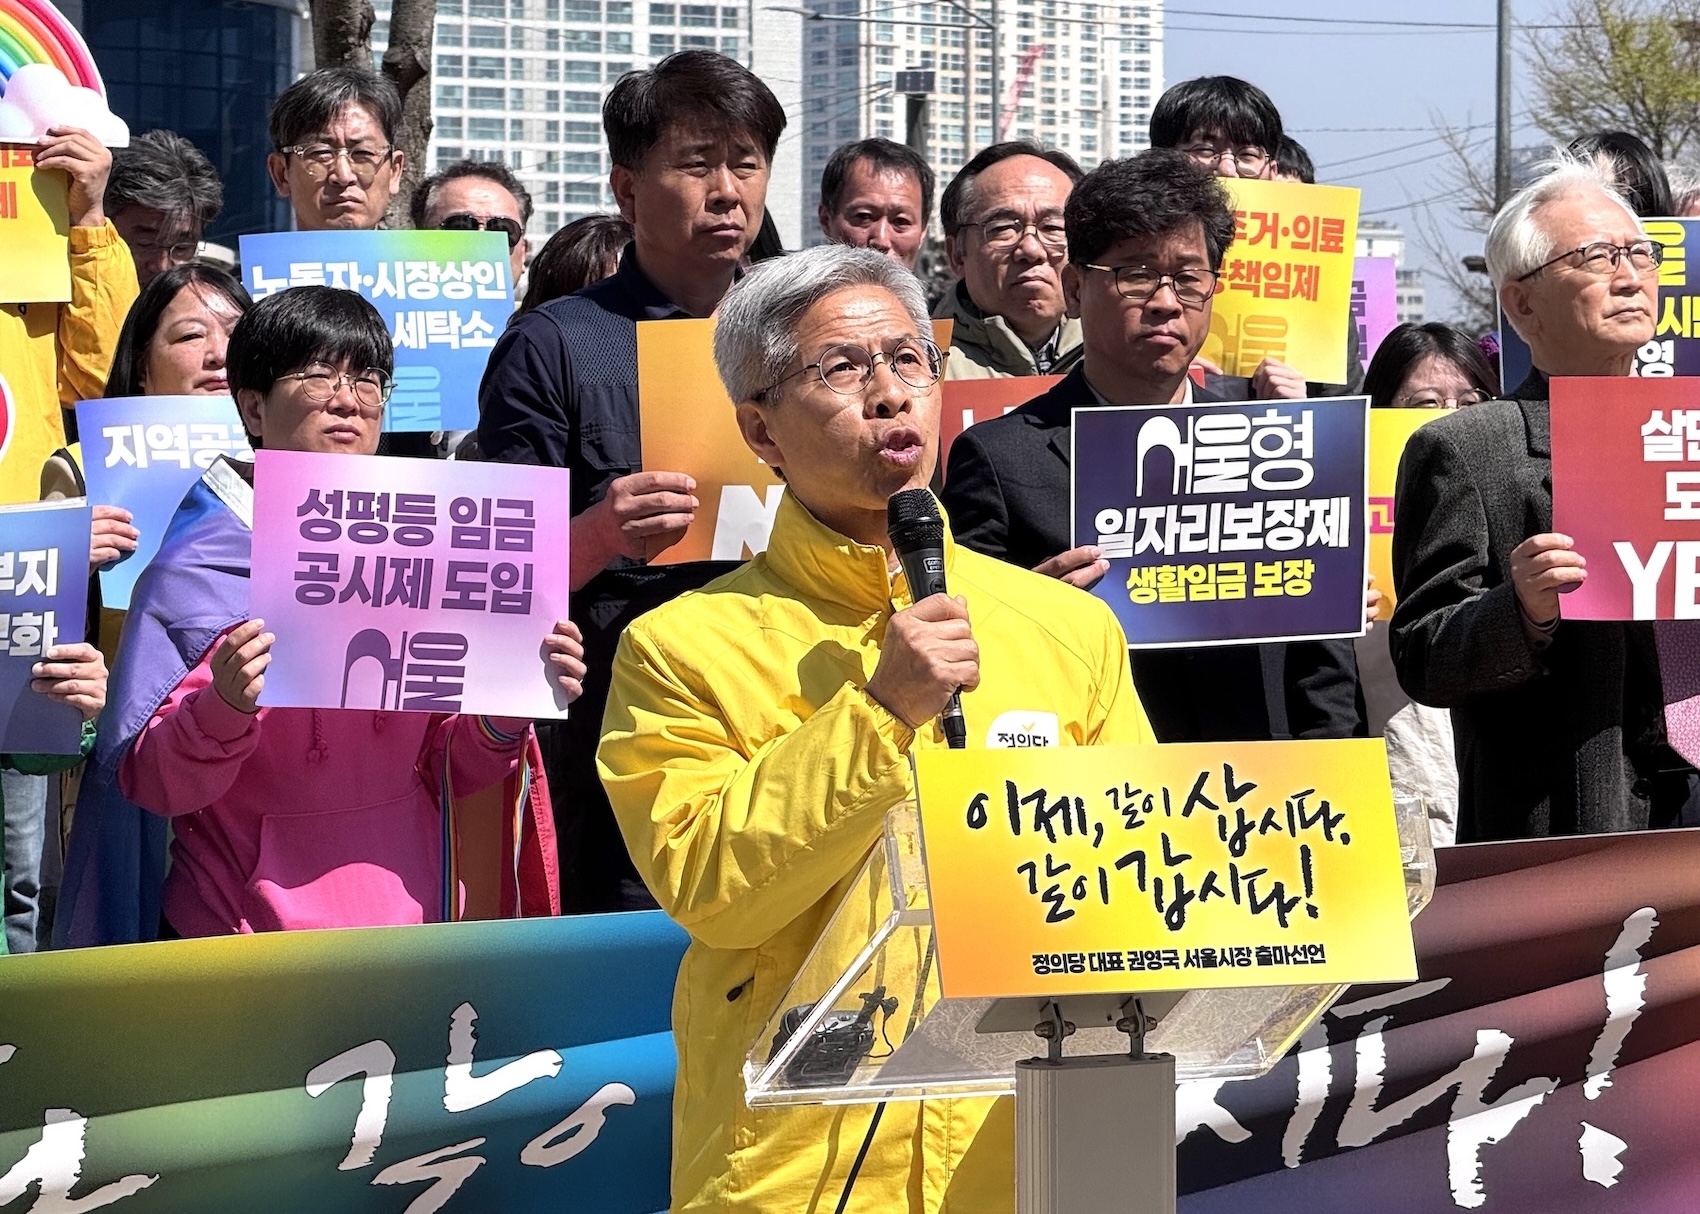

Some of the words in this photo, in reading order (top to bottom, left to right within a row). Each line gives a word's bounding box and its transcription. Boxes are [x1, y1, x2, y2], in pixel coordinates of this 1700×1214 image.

[391, 310, 496, 350] 세탁소
[1656, 296, 1700, 339] 시
[1633, 340, 1675, 378] 영
[1136, 408, 1314, 497] 서울형
[297, 489, 437, 546] 성평등
[449, 496, 536, 552] 임금
[1094, 496, 1350, 559] 일자리보장제
[294, 551, 434, 610] 공시제
[441, 560, 534, 615] 도입
[1126, 562, 1247, 604] 생활임금
[1253, 559, 1315, 597] 보장
[0, 610, 59, 658] 화
[966, 780, 1104, 848] 이제,
[1105, 782, 1171, 830] 같이
[1181, 763, 1351, 857] 삽시다.
[1017, 853, 1108, 923] 같이
[1115, 832, 1319, 931] 갑시다!
[1032, 953, 1086, 975] 정의당
[1088, 951, 1125, 972] 대표
[1127, 949, 1180, 971] 권영국
[1183, 946, 1252, 969] 서울시장
[1254, 943, 1326, 966] 출마선언
